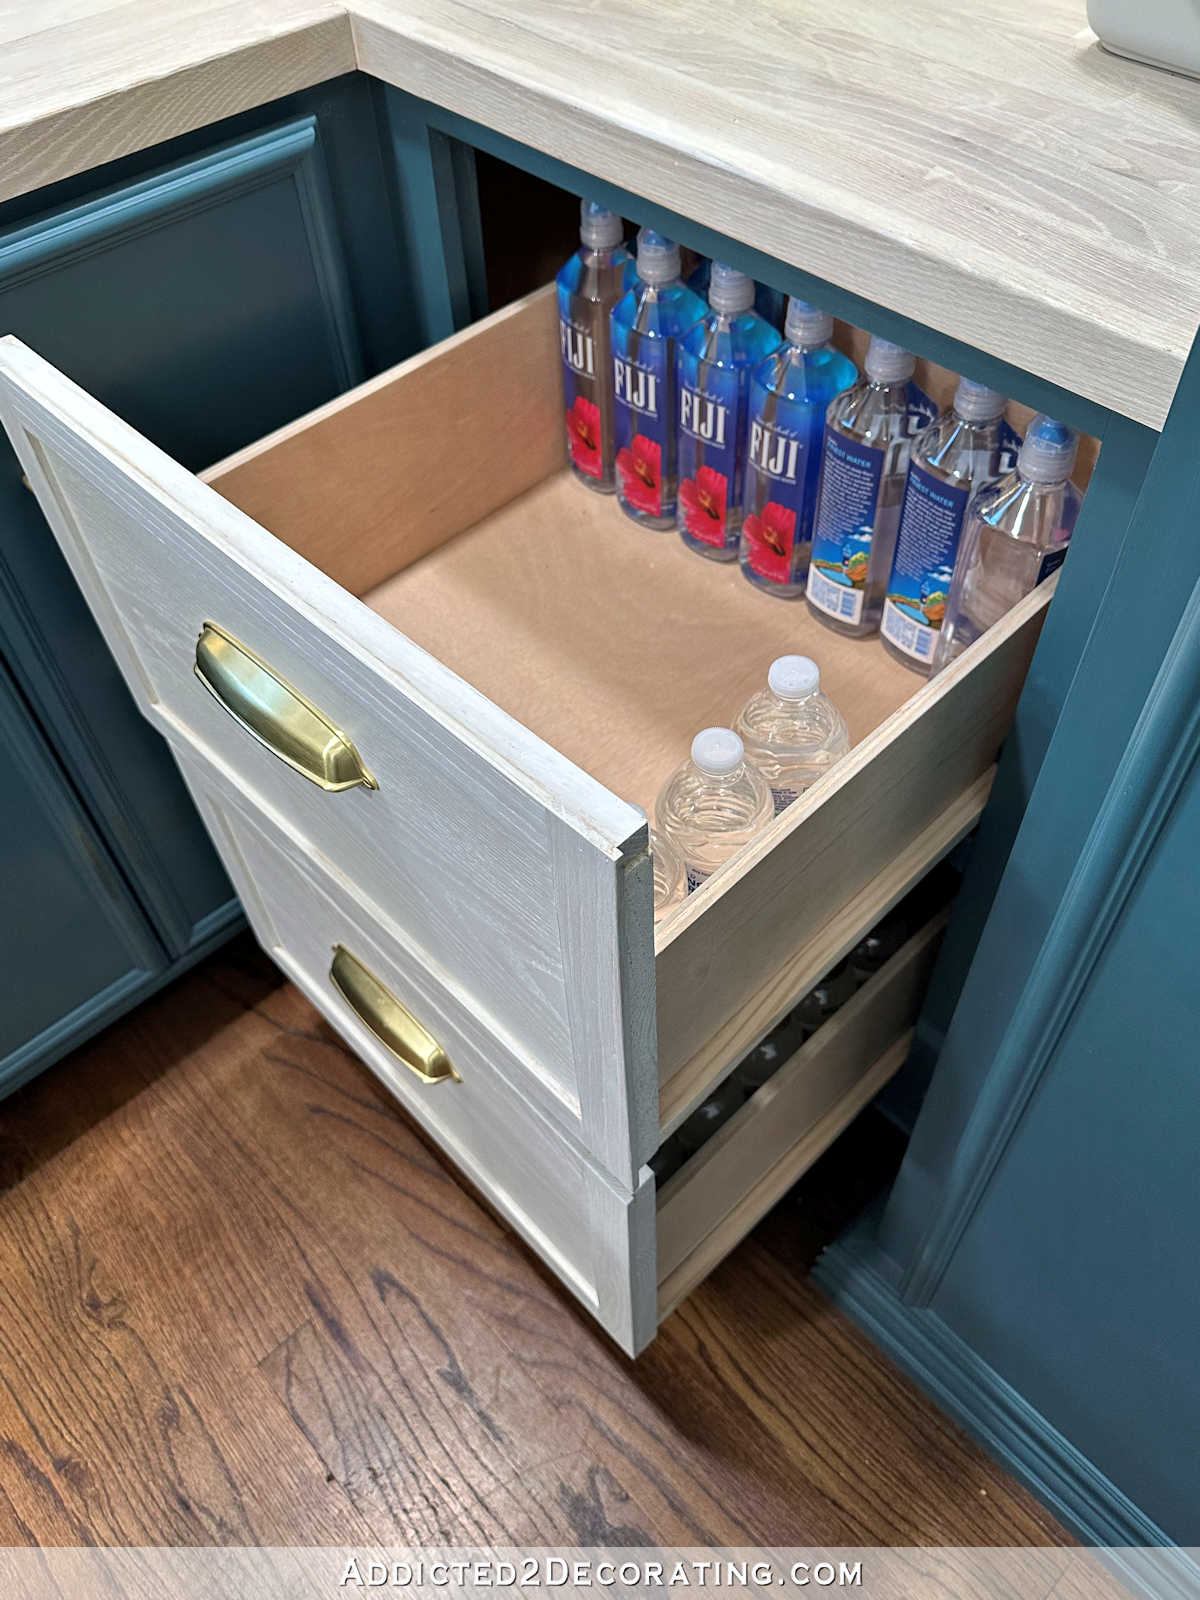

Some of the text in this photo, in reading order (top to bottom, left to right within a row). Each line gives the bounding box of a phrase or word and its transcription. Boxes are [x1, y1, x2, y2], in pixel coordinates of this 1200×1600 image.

[614, 357, 657, 412] FIJI
[680, 387, 727, 444] FIJI
[750, 420, 799, 479] FIJI
